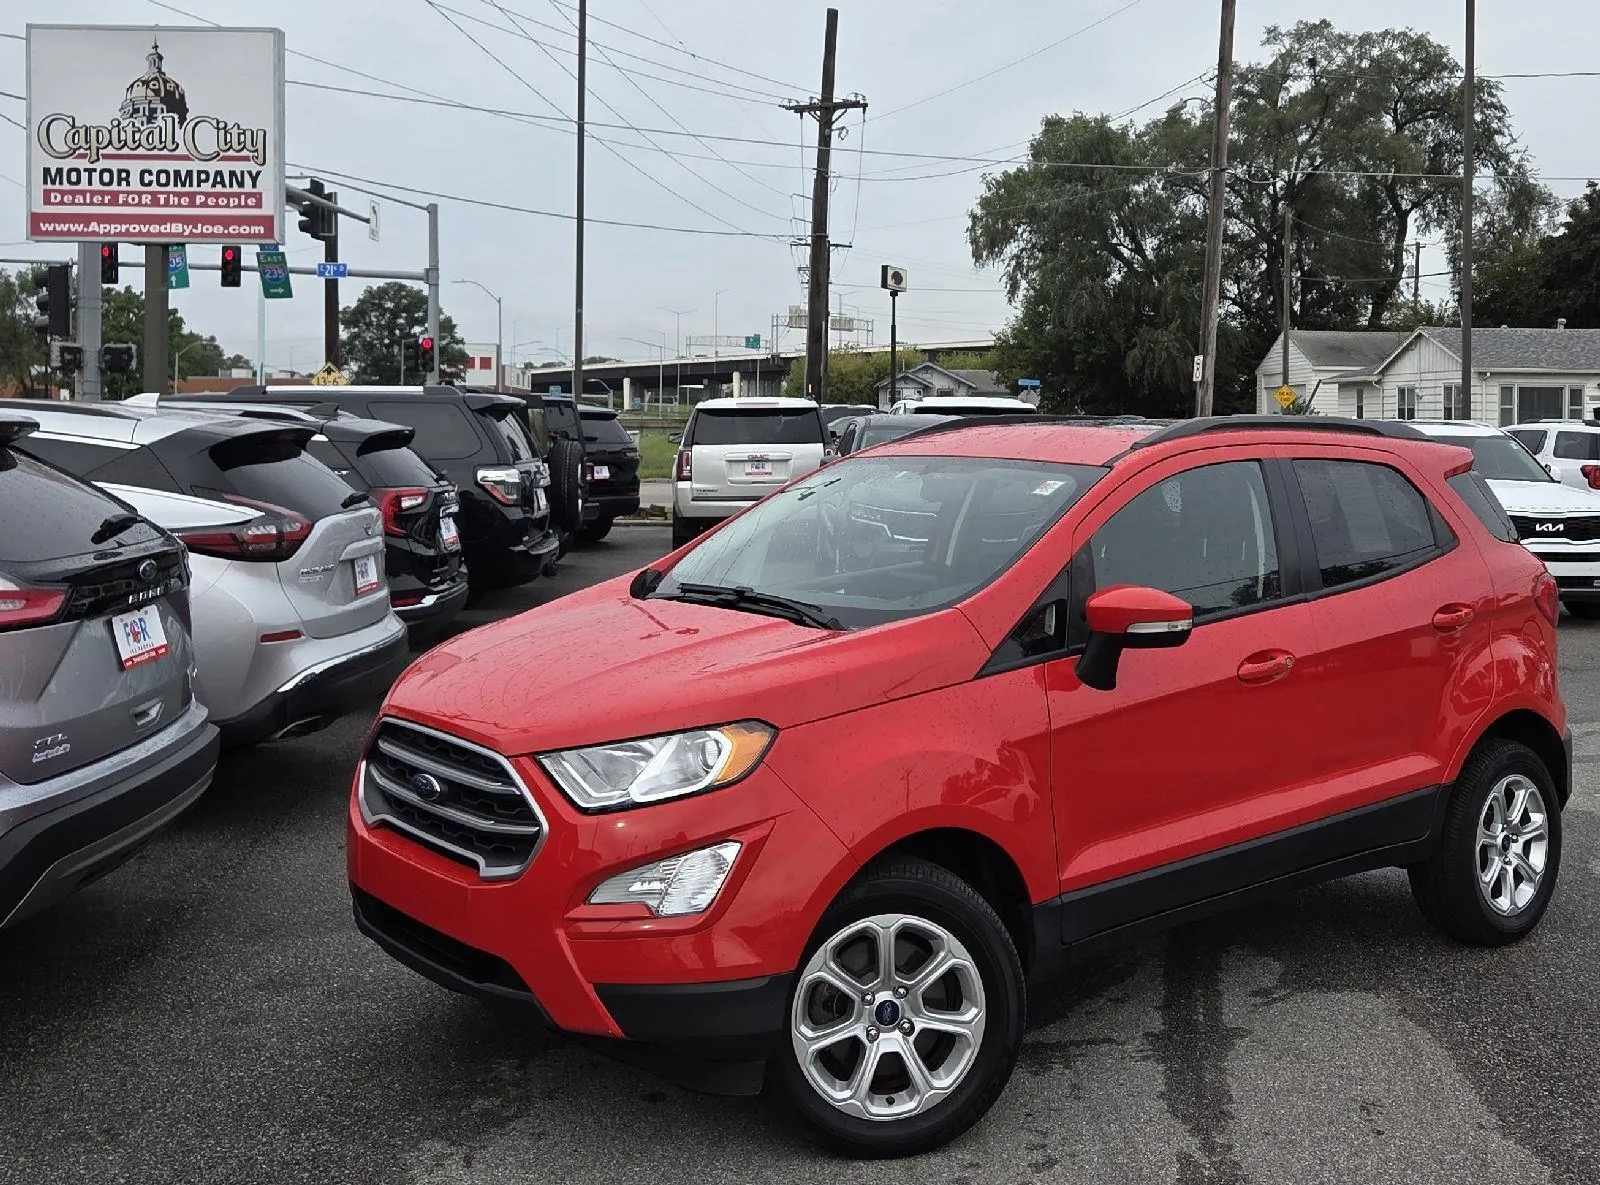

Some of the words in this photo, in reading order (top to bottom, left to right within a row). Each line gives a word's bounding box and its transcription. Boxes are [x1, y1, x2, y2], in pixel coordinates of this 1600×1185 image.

[37, 113, 180, 164] Capital
[183, 115, 267, 166] City
[42, 167, 131, 187] MOTOR
[139, 168, 262, 189] COMPANY
[50, 192, 112, 204] Dealer
[118, 194, 152, 206] FOR
[157, 194, 190, 206] The
[195, 195, 257, 207] People
[39, 220, 265, 236] www.ApprovedByJoe.com
[260, 254, 282, 263] EAST
[264, 268, 285, 279] 235
